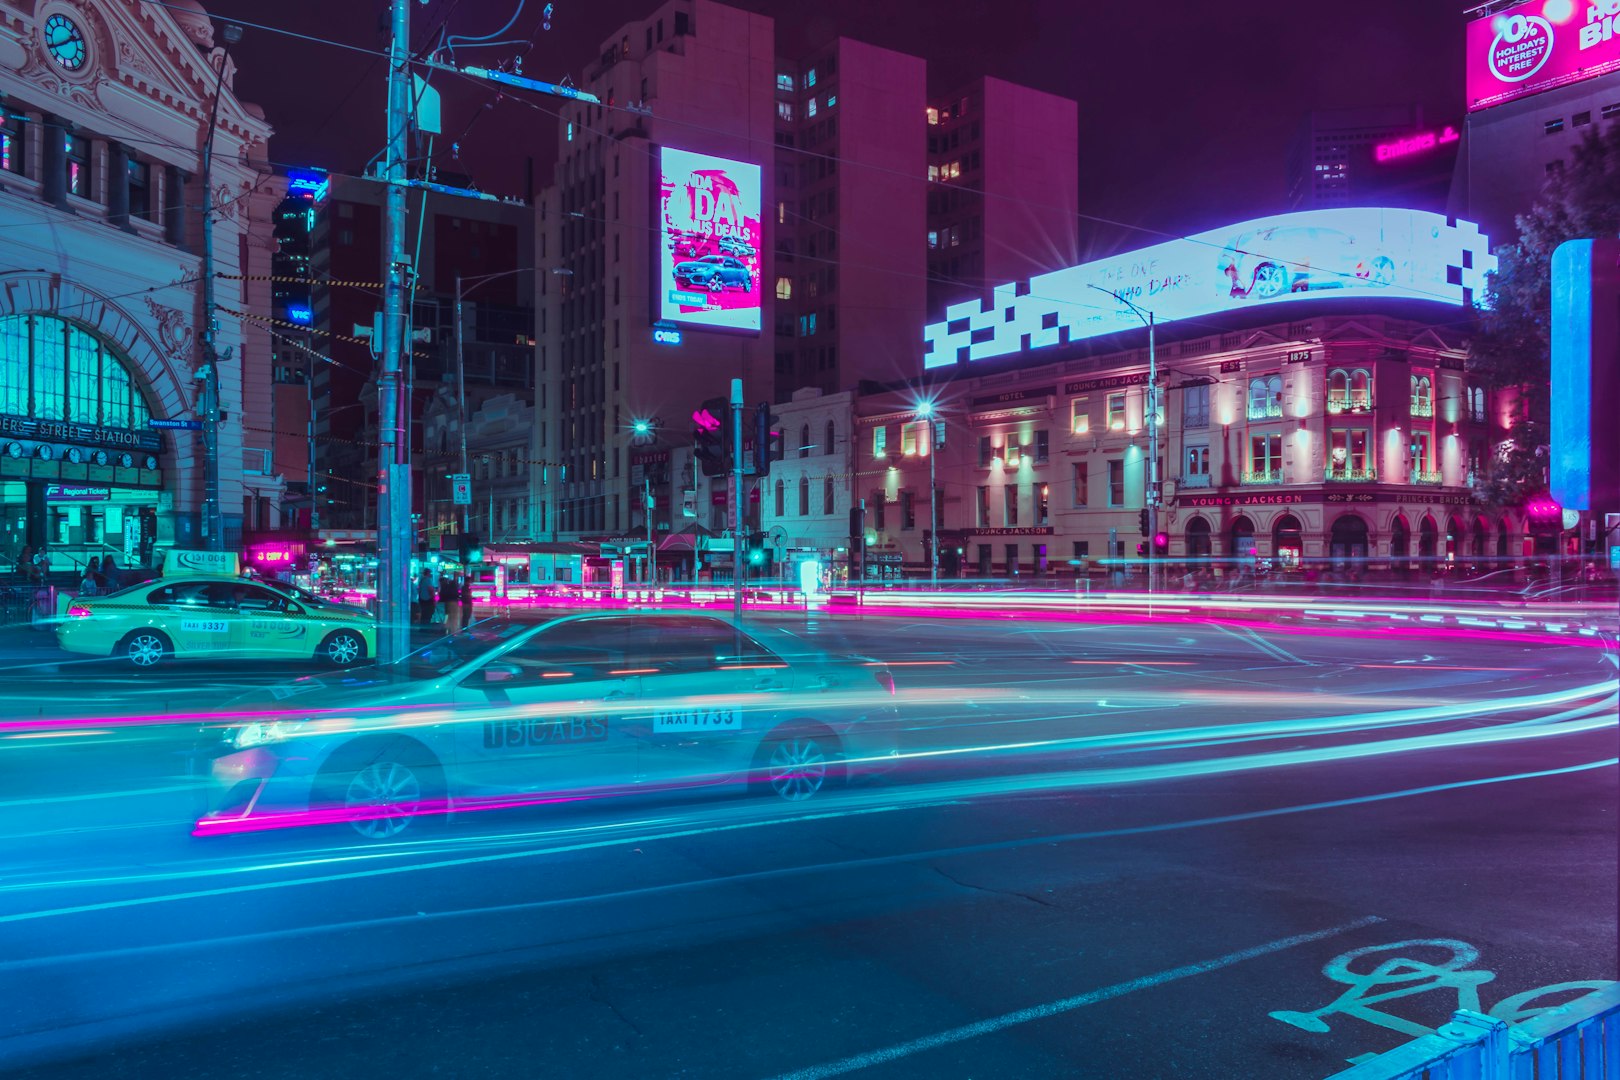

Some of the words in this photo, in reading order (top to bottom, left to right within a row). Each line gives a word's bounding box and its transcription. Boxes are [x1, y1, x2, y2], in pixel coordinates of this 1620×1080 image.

[1496, 36, 1546, 59] HOLIDAYS
[1497, 46, 1544, 68] INTEREST
[715, 222, 750, 240] DEALS
[1290, 352, 1309, 361] 1875
[1068, 382, 1097, 392] YOUNG
[1100, 377, 1117, 387] AND
[1000, 392, 1025, 401] HOTEL
[149, 419, 180, 427] Swanston
[0, 418, 25, 431] ERS
[40, 423, 83, 438] STREET
[94, 430, 140, 444] STATION
[63, 488, 88, 496] Regional
[1192, 498, 1231, 506] YOUNG
[1245, 495, 1302, 504] JACKSON
[1440, 496, 1470, 505] BRIDGE
[1009, 527, 1047, 535] JACKSON
[202, 622, 225, 631] 9337
[659, 711, 688, 725] TAXI
[693, 708, 734, 725] 1733
